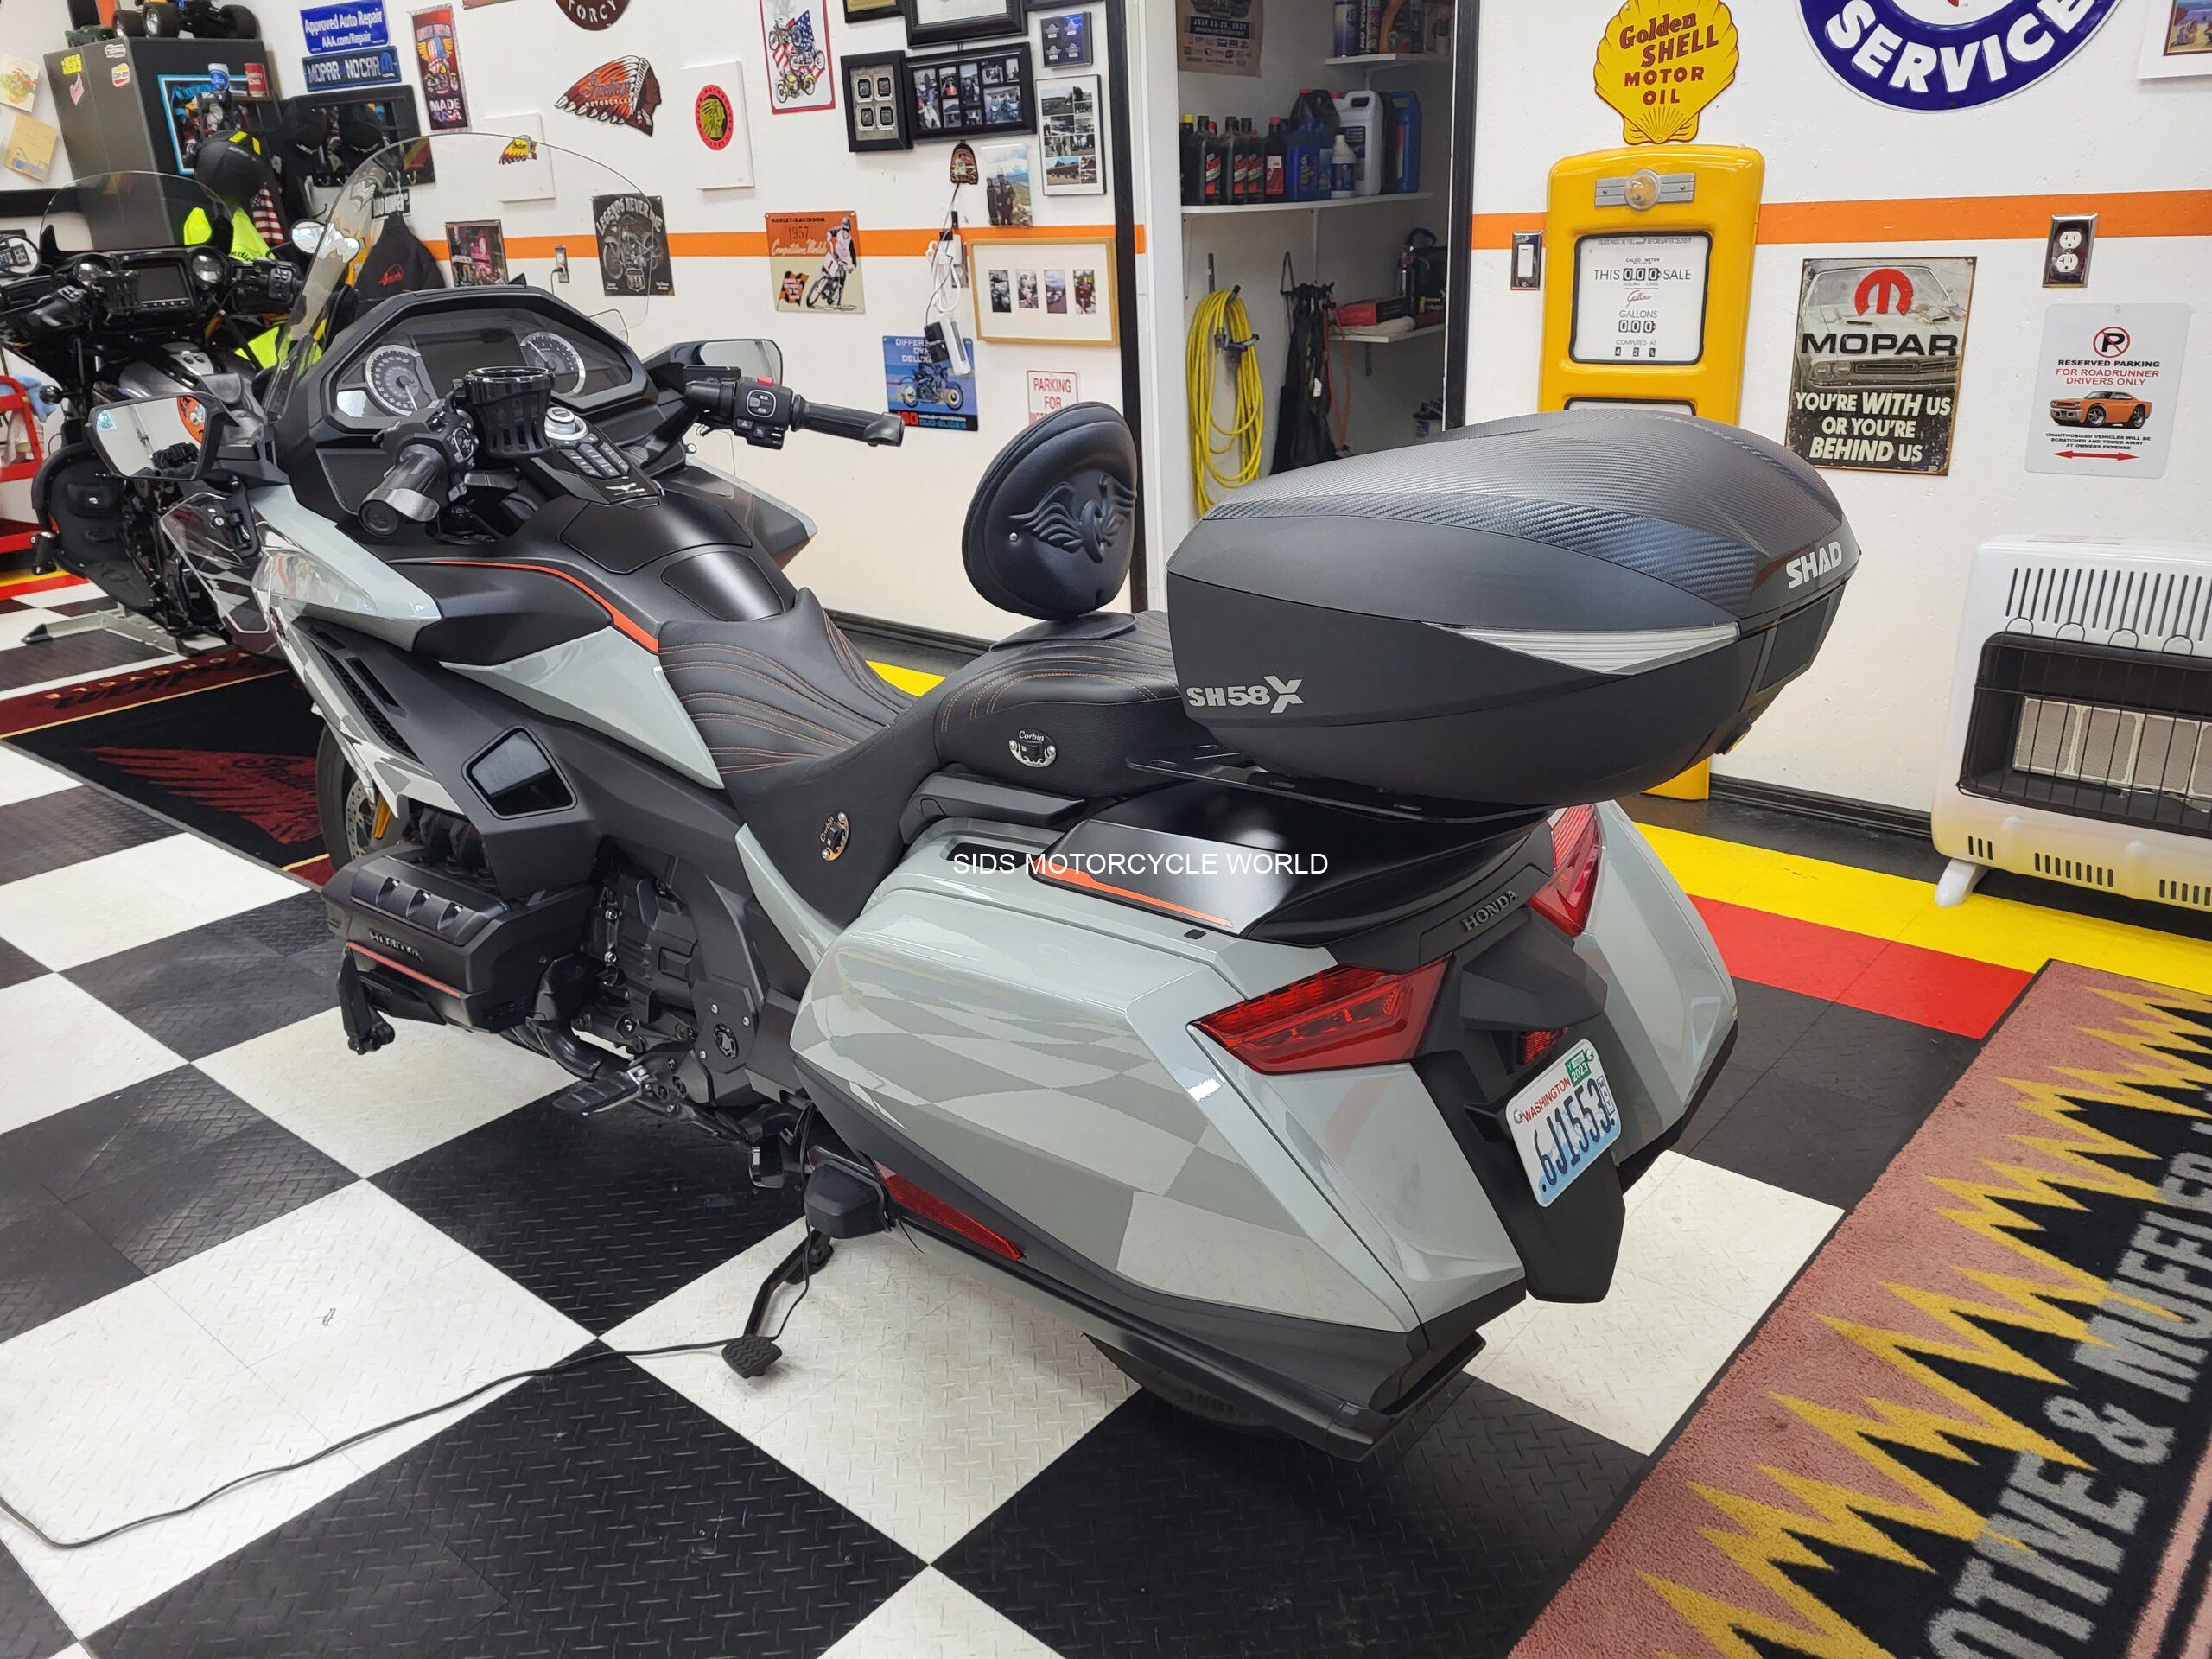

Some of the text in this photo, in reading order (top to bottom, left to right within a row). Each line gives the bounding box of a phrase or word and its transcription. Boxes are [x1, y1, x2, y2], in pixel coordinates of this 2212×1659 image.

[304, 7, 383, 36] Approved Auto Repair
[1619, 12, 1697, 49] Golden
[321, 30, 372, 48] AAA.com/Repair
[1641, 24, 1719, 68] SHELL
[1826, 0, 2094, 92] SERVICE
[306, 60, 341, 83] MOPAR
[359, 56, 381, 78] CAR
[1624, 66, 1705, 87] MOTOR
[429, 98, 461, 111] MADE
[1643, 88, 1681, 105] OIL
[595, 197, 626, 236] LEGENDS
[625, 196, 650, 218] NEVER
[788, 226, 810, 240] 1957
[1594, 269, 1620, 280] THIS
[1662, 269, 1692, 280] SALE
[1619, 309, 1658, 319] GALLONS
[895, 338, 925, 346] DIFFER
[1802, 333, 1958, 356] MOPAR
[2066, 377, 2146, 386] DRIVERS ONLY
[2080, 369, 2160, 378] ROADRUNNER
[1033, 378, 1071, 393] PARKING
[1044, 396, 1062, 410] FOR
[1795, 391, 1952, 416] YOU'RE WITH US
[1821, 416, 1917, 439] OR YOU'RE
[1809, 436, 1923, 463] BEHIND US
[1785, 541, 1842, 589] SHAD
[1186, 675, 1305, 714] SH58X
[1019, 730, 1045, 741] Corbin
[1461, 889, 1519, 931] HONDA
[1571, 1064, 1589, 1082] 2023
[1521, 1076, 1571, 1122] WASHINGTON
[1534, 1077, 1612, 1186] 6J1553
[1926, 1449, 2146, 1659] OTIVE
[2043, 1395, 2175, 1464] &
